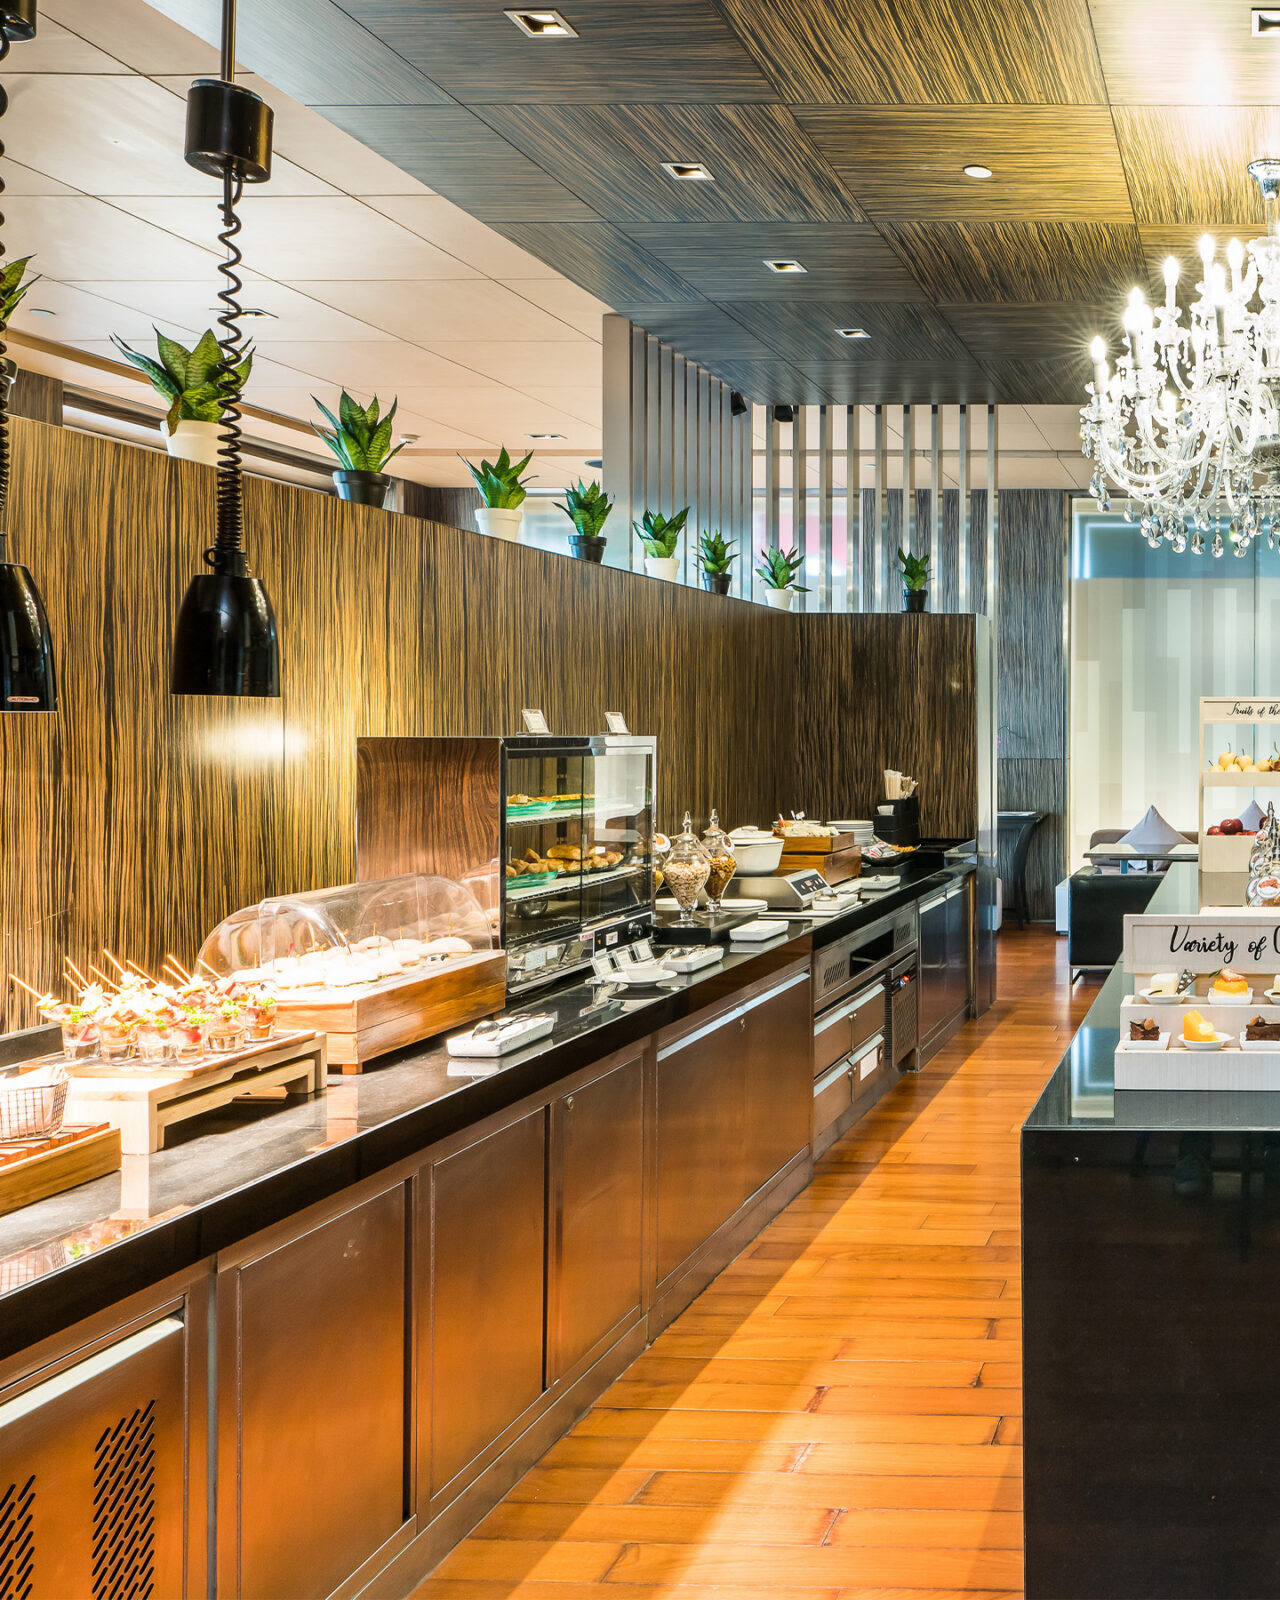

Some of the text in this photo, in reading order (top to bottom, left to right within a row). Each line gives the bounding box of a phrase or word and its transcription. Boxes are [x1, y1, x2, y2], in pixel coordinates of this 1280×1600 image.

[1257, 706, 1266, 718] of
[1169, 925, 1239, 965] Variety
[1247, 936, 1268, 961] of
